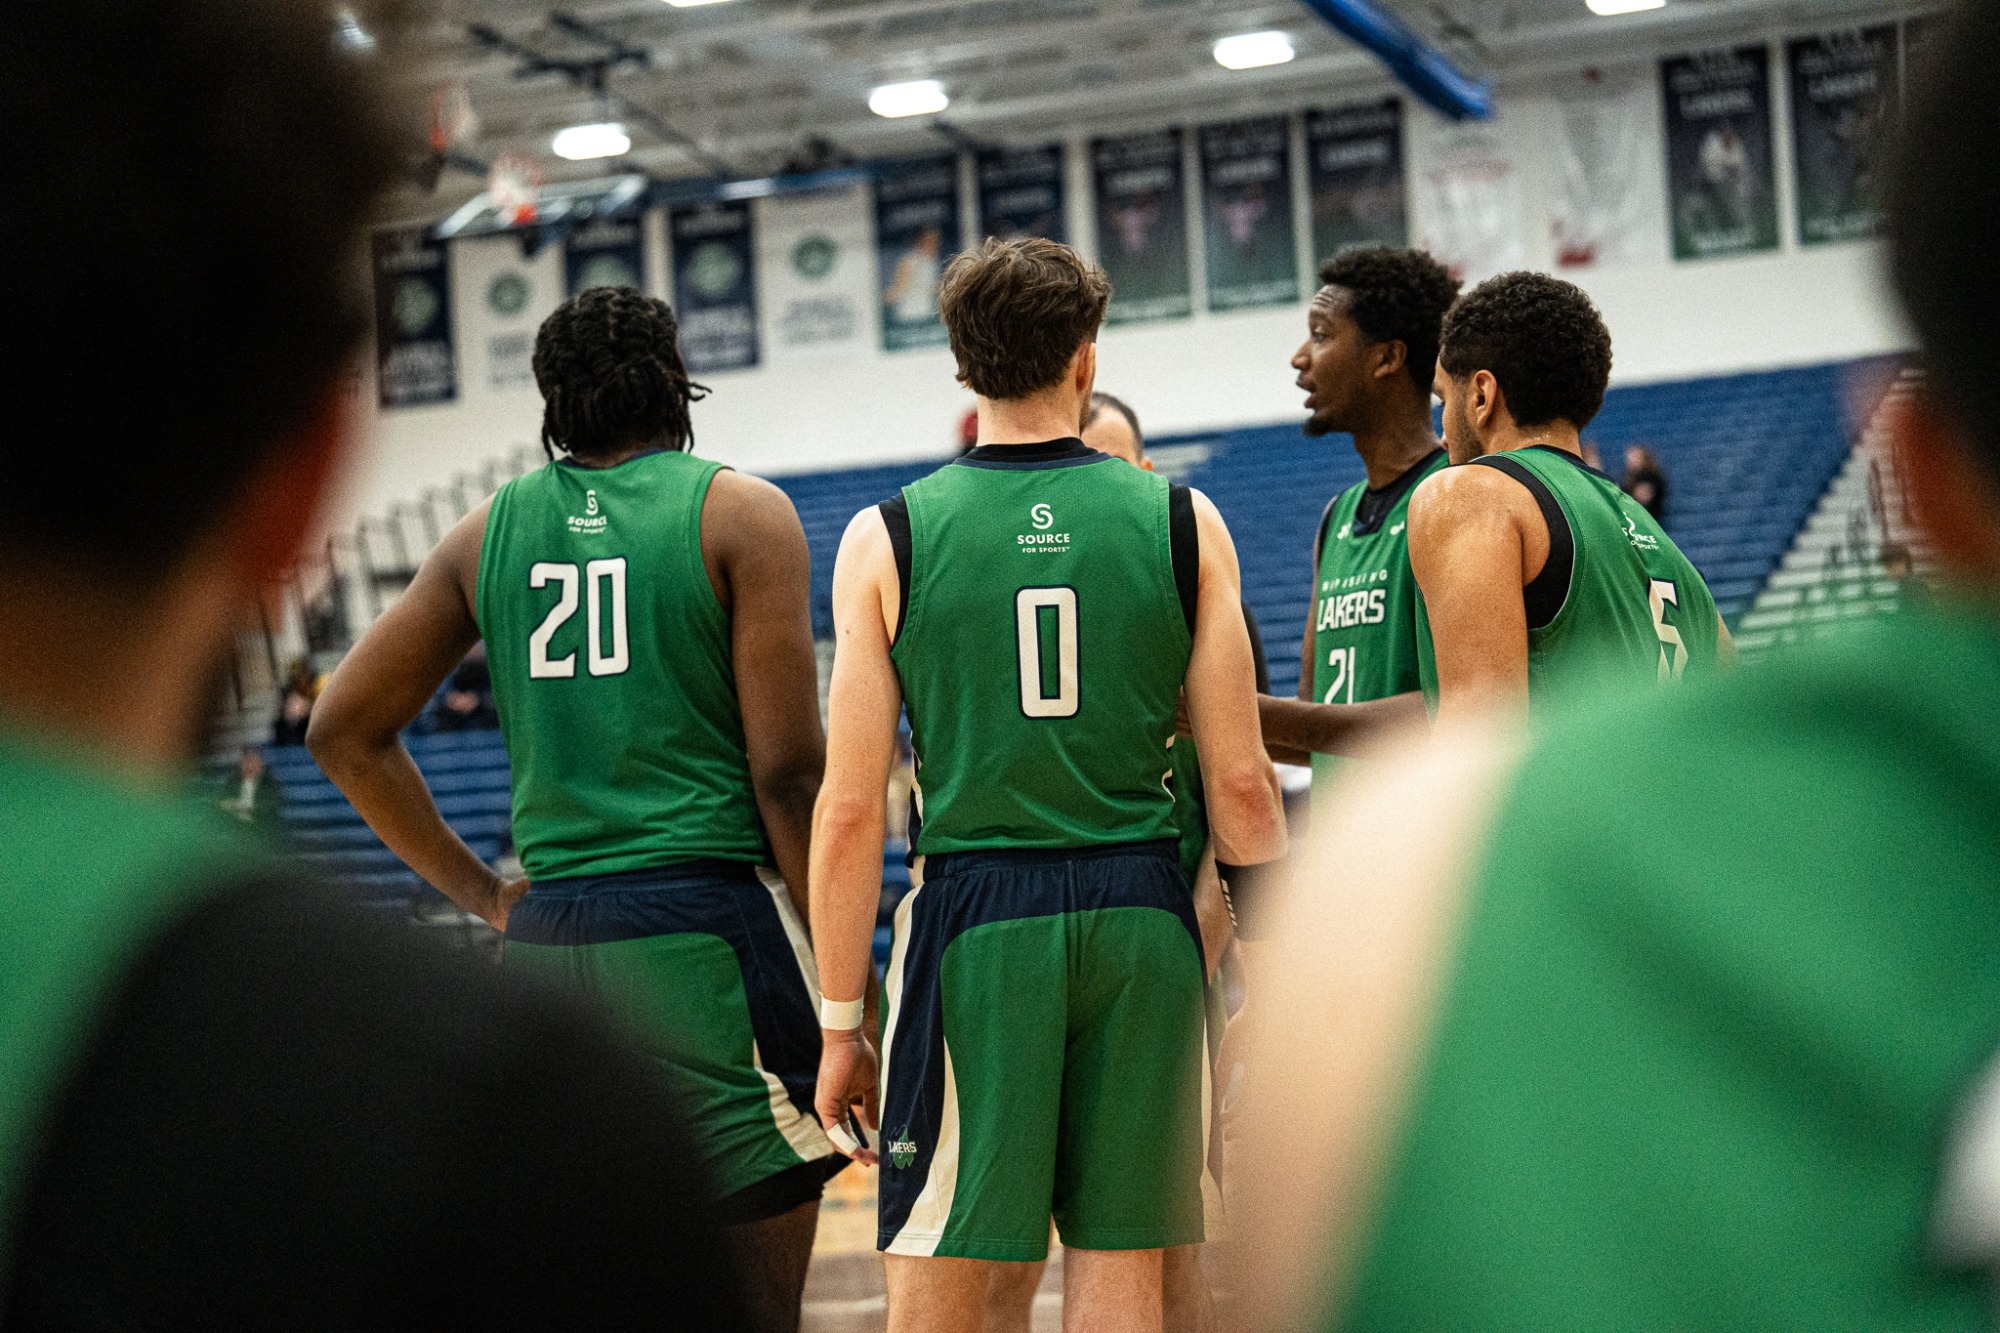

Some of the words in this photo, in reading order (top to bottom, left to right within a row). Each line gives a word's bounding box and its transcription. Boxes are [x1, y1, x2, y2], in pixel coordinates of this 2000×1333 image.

[1017, 533, 1070, 545] SOURCE
[529, 557, 629, 679] 20
[1317, 589, 1386, 632] LAKERS
[1015, 585, 1081, 719] 0
[1324, 646, 1355, 705] 21
